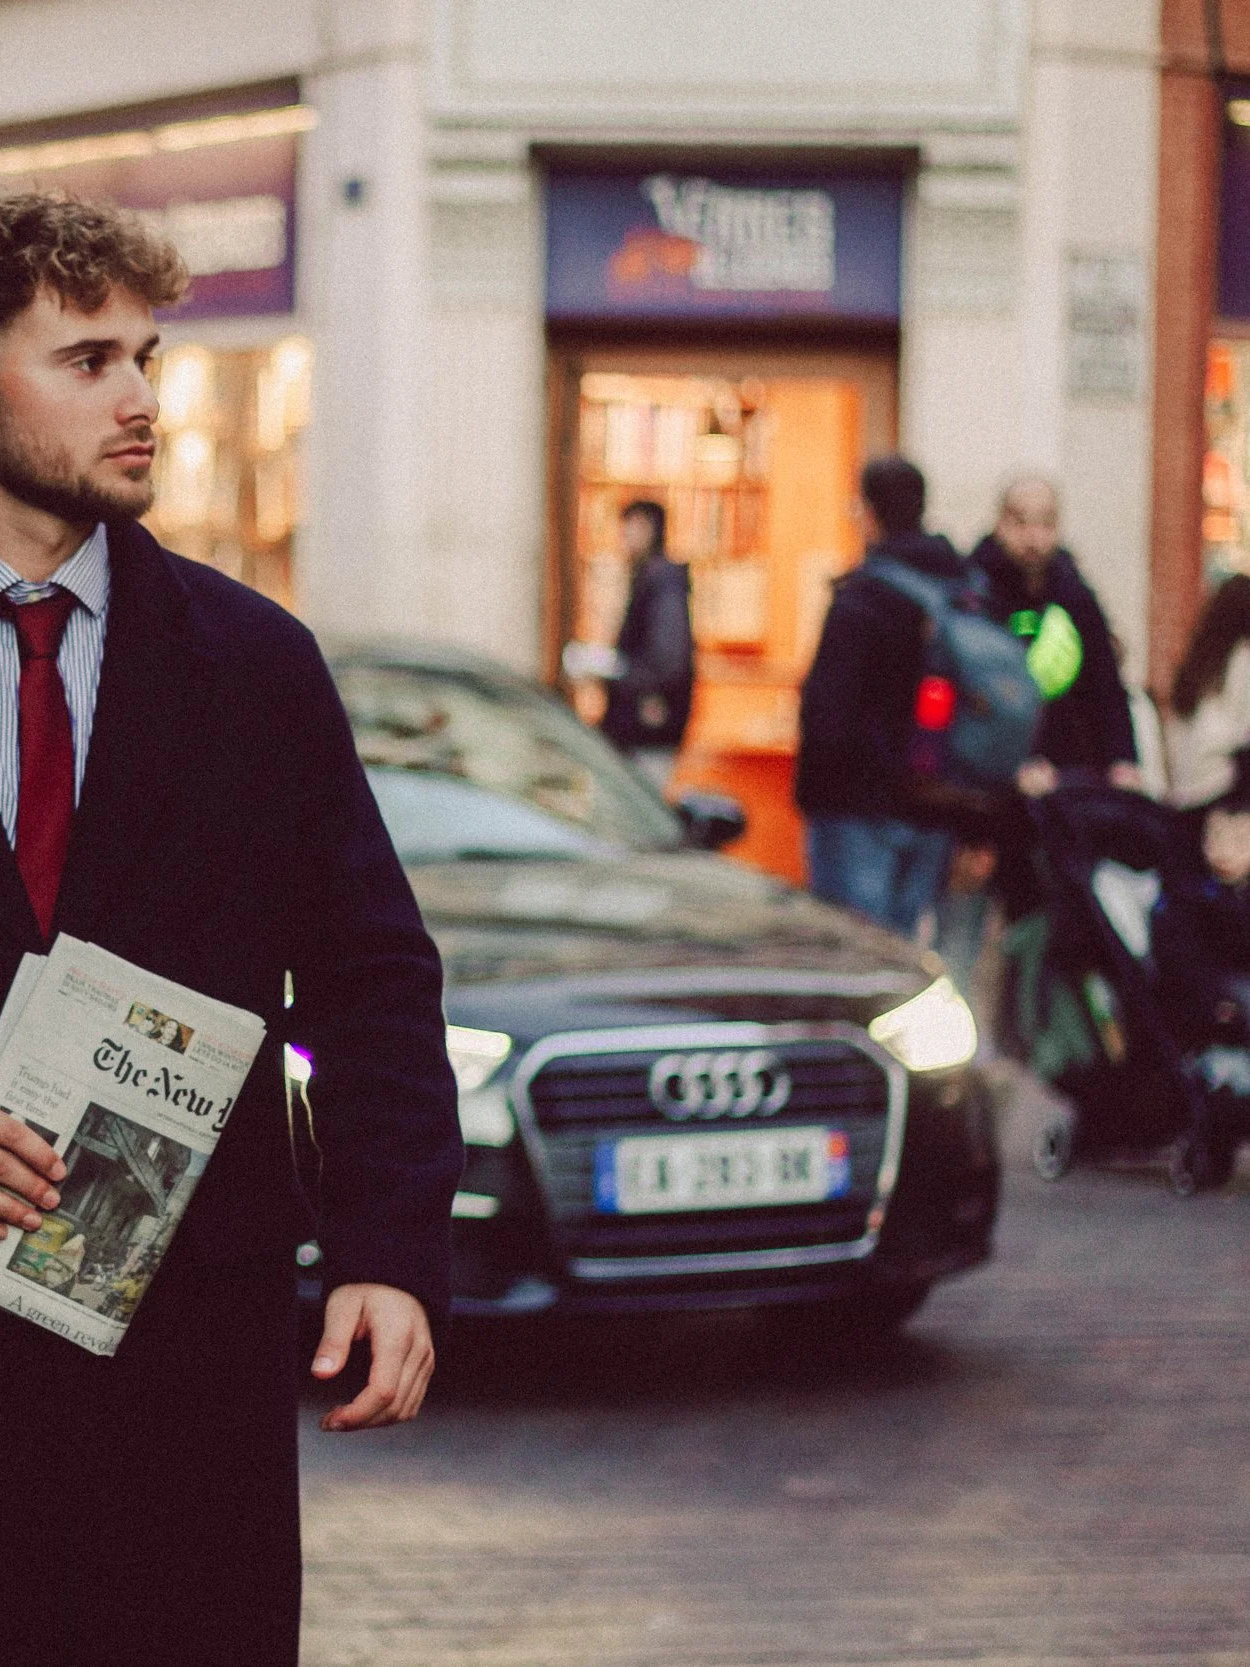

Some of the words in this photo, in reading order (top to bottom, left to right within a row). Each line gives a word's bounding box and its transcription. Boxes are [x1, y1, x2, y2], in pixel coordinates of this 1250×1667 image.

[93, 1038, 148, 1086] The
[146, 1067, 214, 1116] New
[8, 1295, 23, 1312] A
[26, 1307, 70, 1335] green
